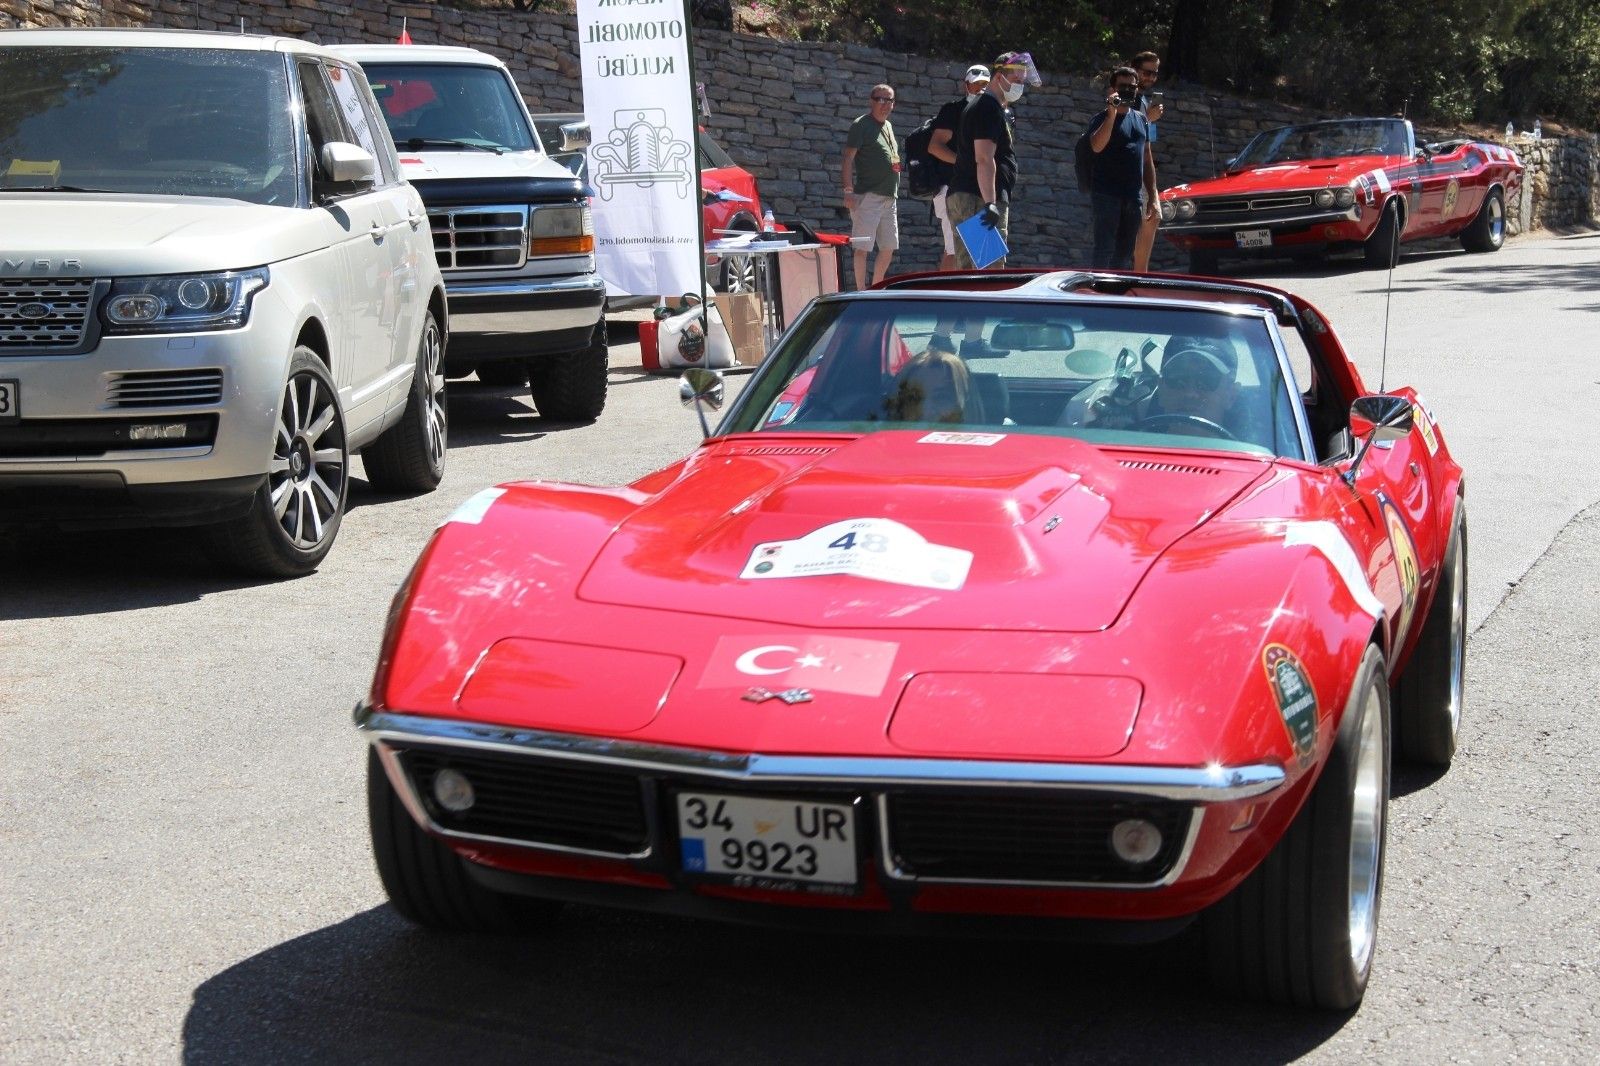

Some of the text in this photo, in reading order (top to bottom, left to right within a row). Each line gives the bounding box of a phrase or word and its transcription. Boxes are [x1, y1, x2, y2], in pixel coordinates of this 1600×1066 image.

[1237, 232, 1246, 240] 34
[828, 531, 890, 553] 48
[685, 797, 848, 842] 34 UR
[721, 838, 819, 876] 9923
